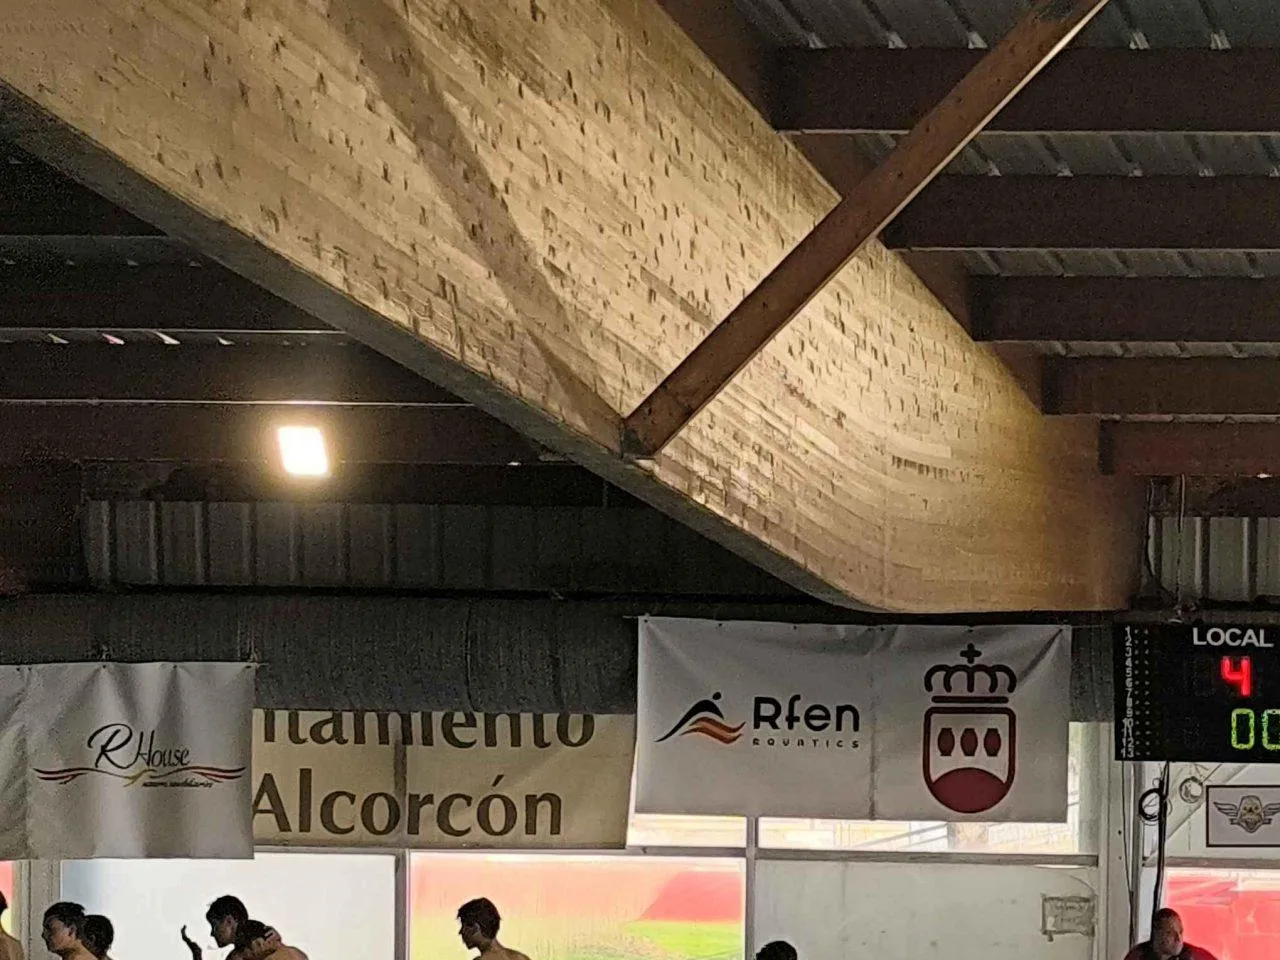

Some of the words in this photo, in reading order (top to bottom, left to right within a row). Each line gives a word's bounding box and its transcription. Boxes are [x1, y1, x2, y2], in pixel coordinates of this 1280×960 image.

[1192, 627, 1274, 648] LOCAL
[1221, 656, 1251, 697] 4
[753, 694, 859, 732] Rfen
[252, 768, 562, 836] Alcorcón
